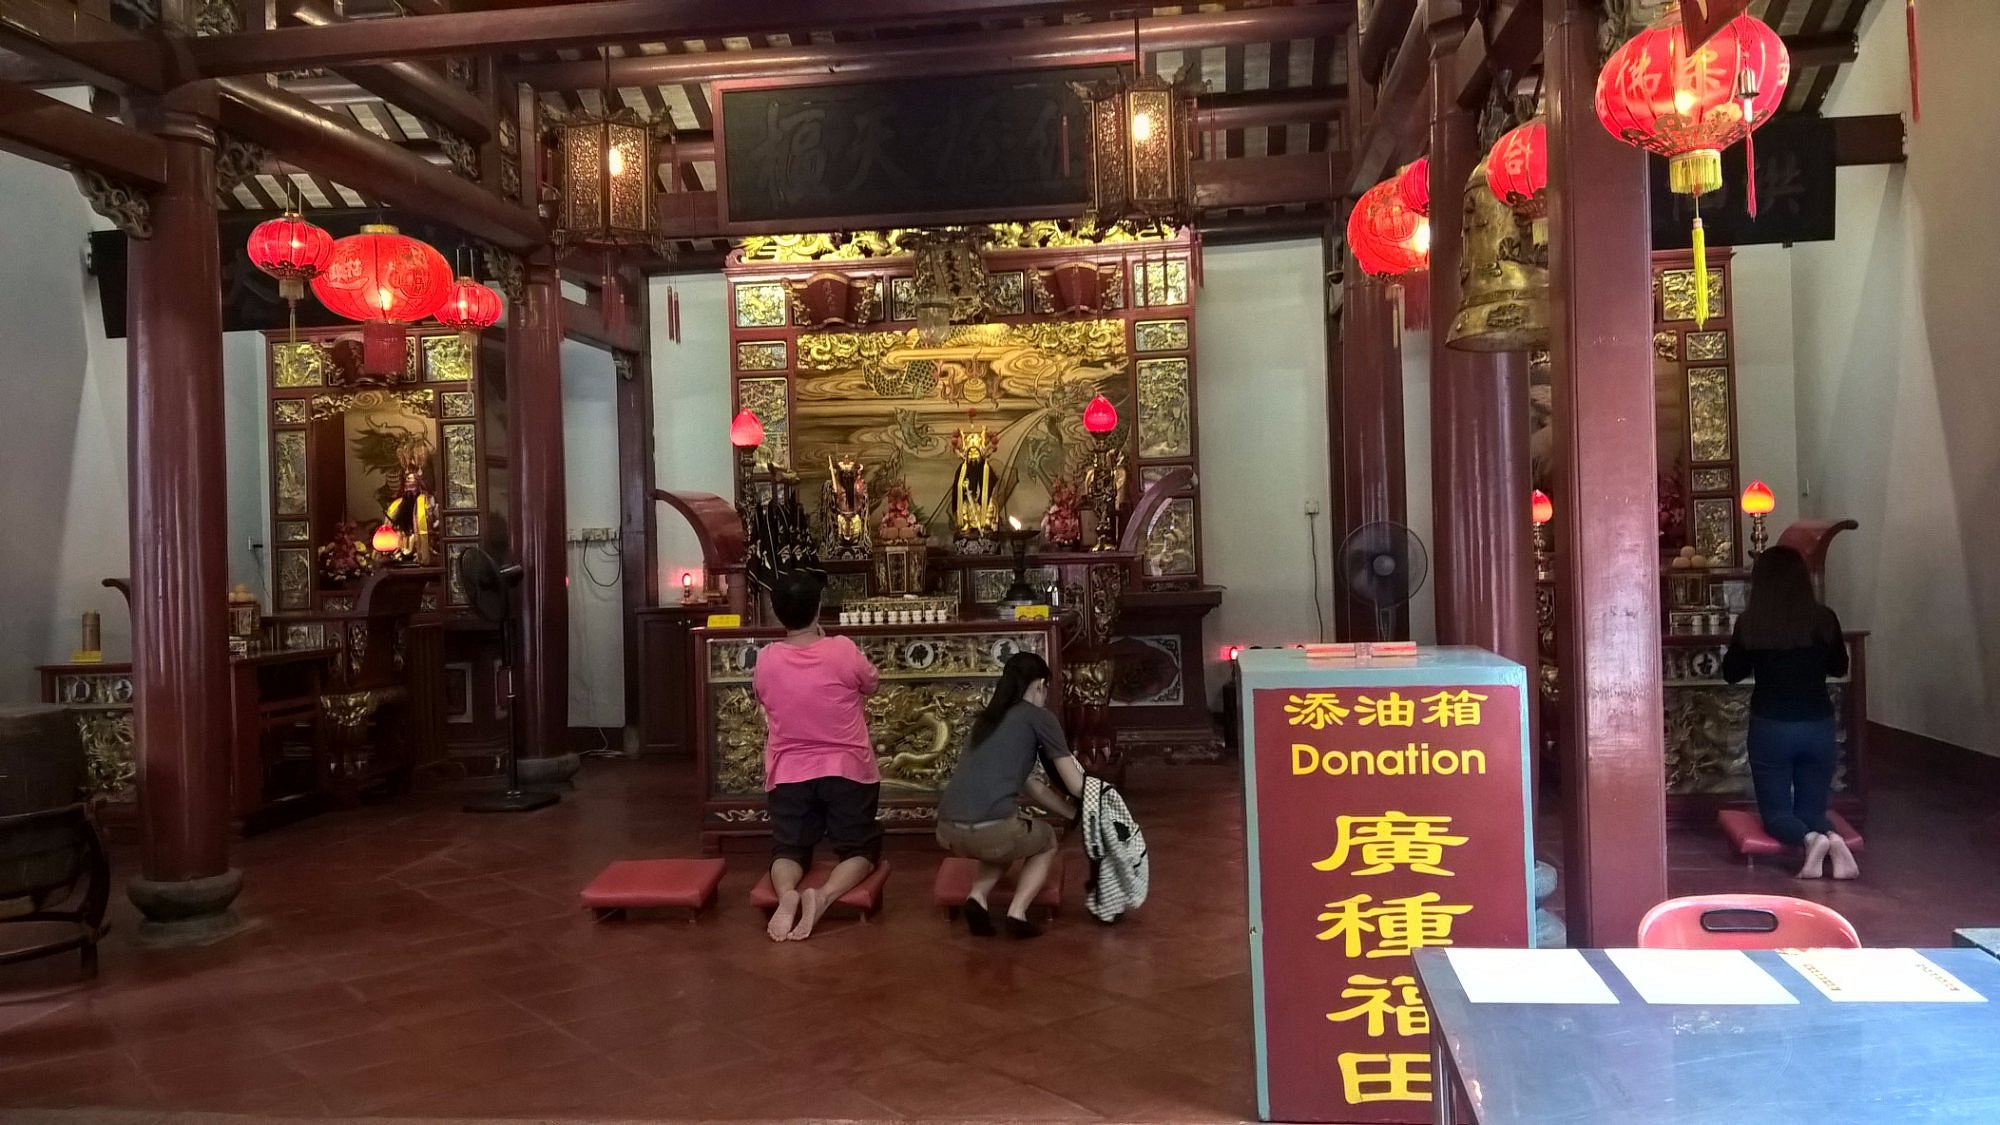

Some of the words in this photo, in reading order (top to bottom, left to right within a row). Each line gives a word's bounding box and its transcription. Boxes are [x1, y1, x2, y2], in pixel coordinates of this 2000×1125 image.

[1284, 690, 1488, 729] 添油箱
[1292, 743, 1486, 775] Donation
